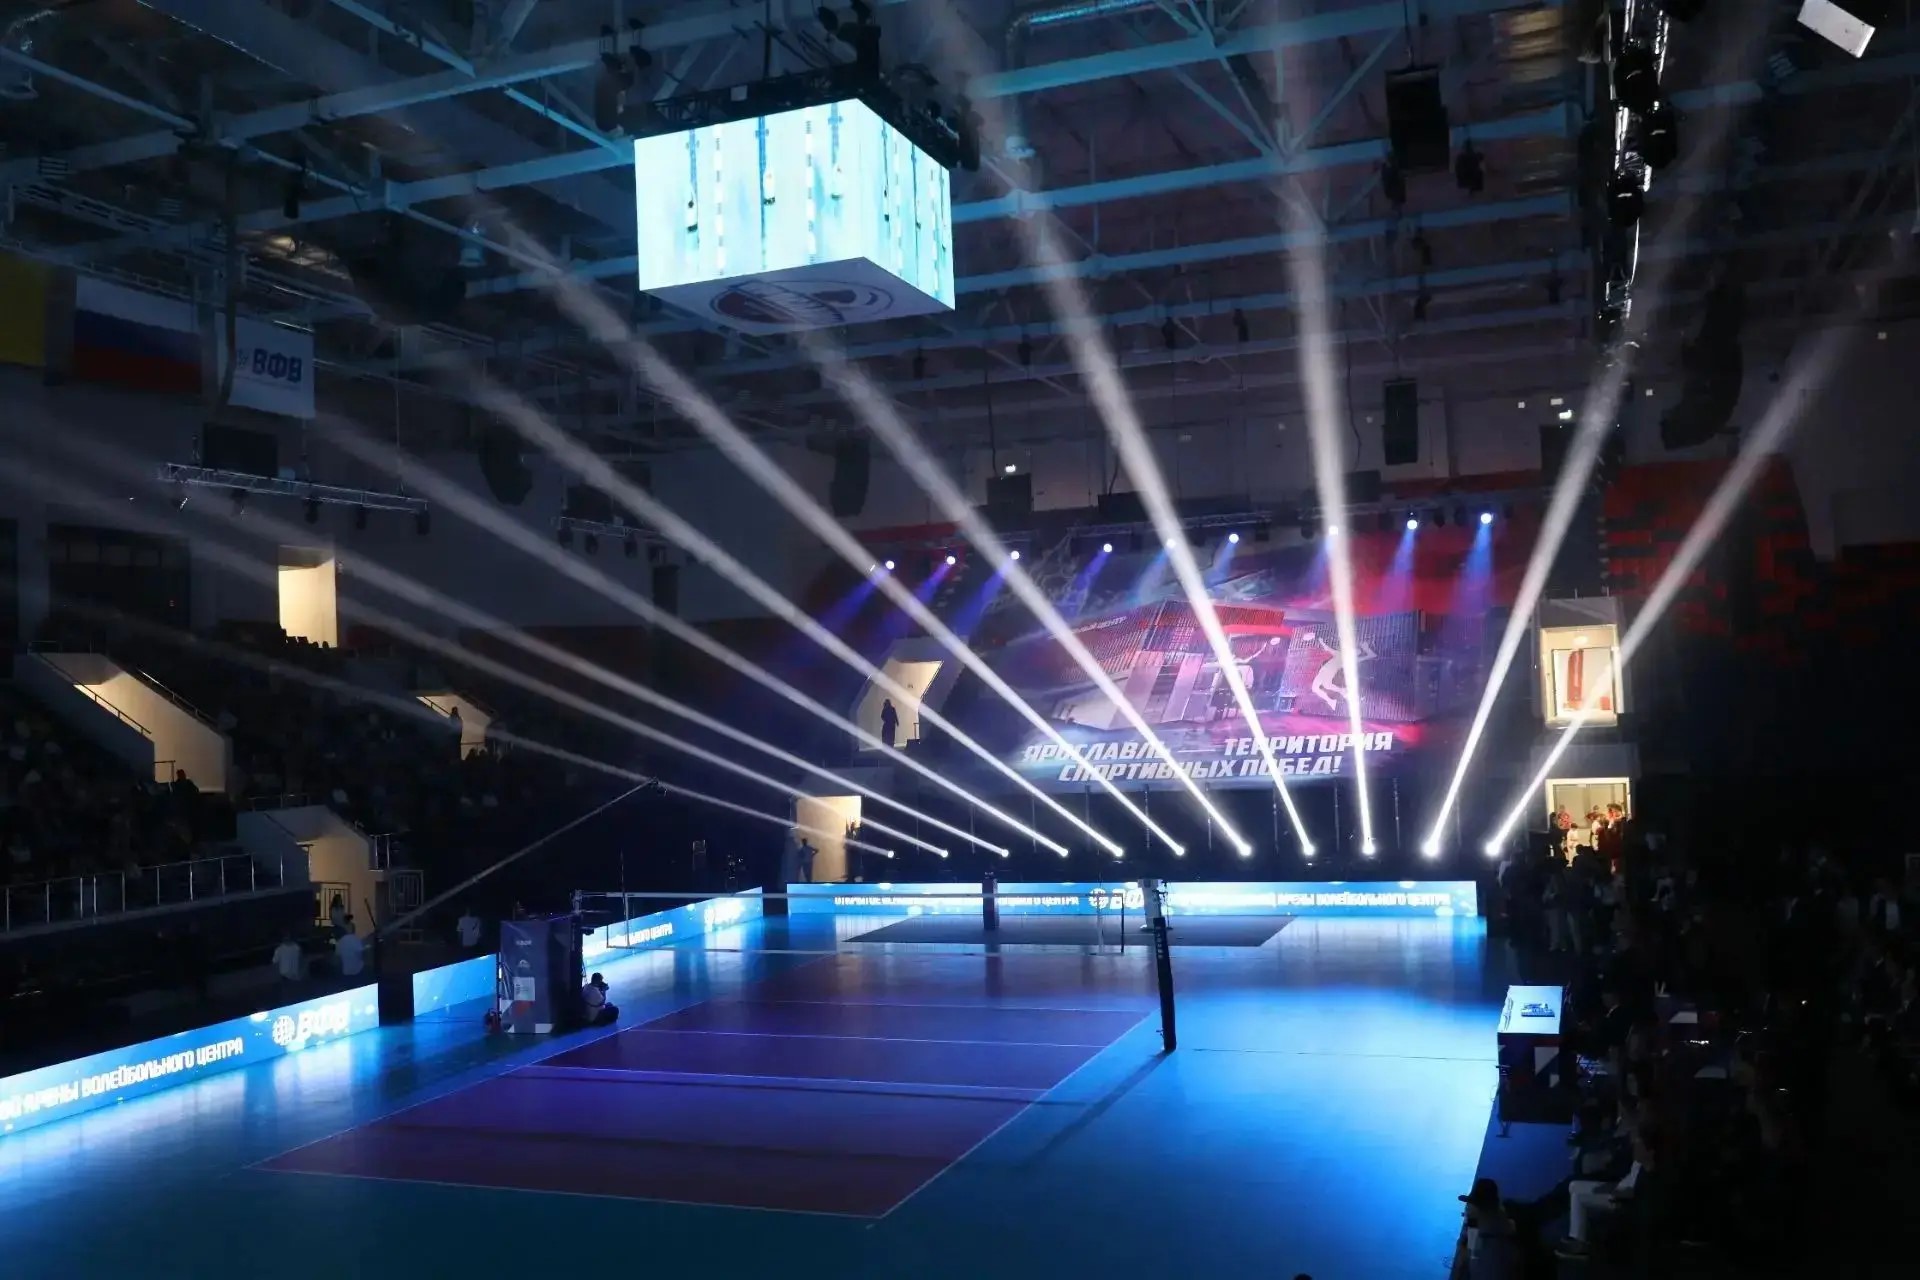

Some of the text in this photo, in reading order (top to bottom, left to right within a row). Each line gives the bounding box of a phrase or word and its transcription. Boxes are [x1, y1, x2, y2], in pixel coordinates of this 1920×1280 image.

[252, 348, 302, 383] ВФВ
[1224, 732, 1394, 756] ТЕРРИТОРИЯ
[1058, 755, 1343, 781] СПОРТИВНЫХ ПОБЕД!
[82, 1051, 194, 1097] ВОЛЕЙБОЛЬНОГО
[197, 1037, 244, 1066] ЦЕНТРА
